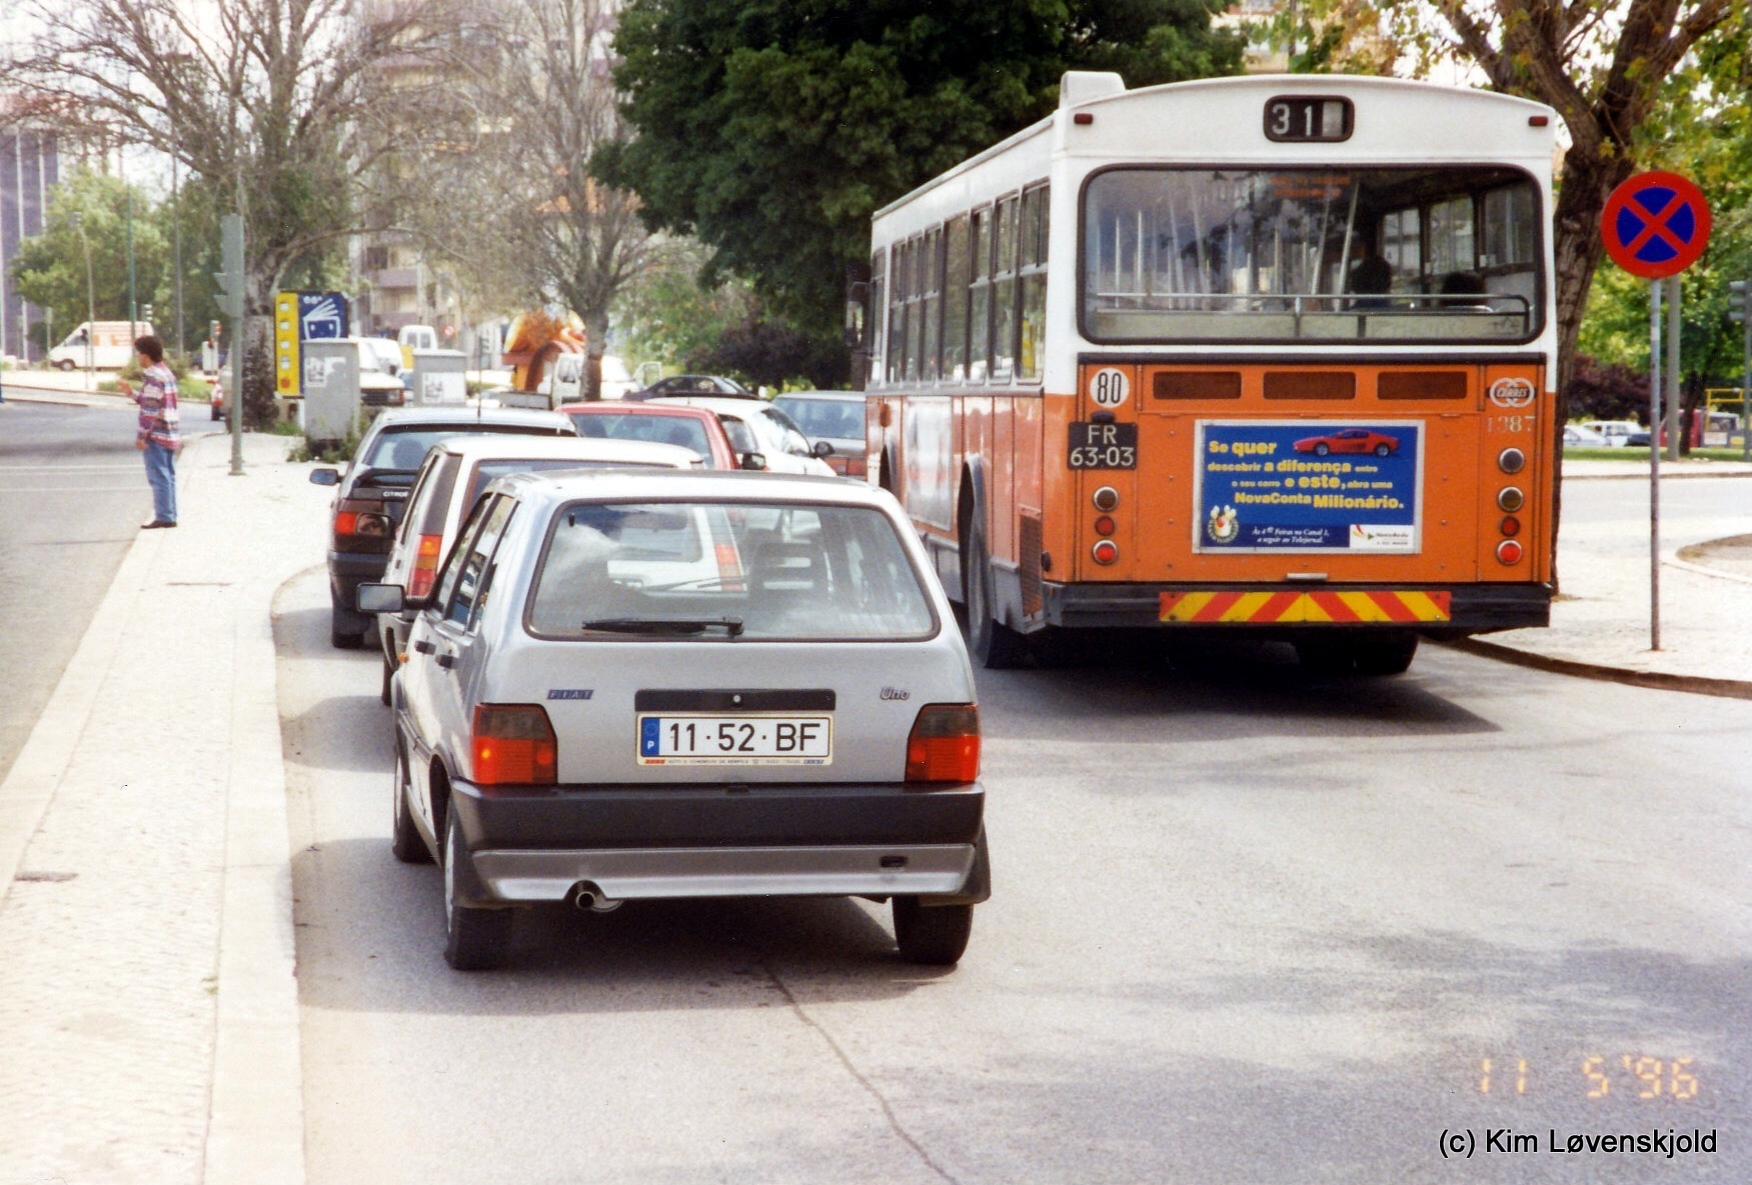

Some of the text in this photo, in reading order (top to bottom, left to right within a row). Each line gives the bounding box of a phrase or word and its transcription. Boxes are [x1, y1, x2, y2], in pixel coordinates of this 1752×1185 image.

[1272, 103, 1312, 136] 31
[1098, 372, 1121, 404] 80
[1088, 425, 1117, 444] FR
[1070, 446, 1134, 466] 63-03
[1208, 440, 1277, 457] Se quer
[1207, 461, 1262, 472] descobrir
[1264, 462, 1274, 472] a
[1276, 459, 1351, 475] diferença
[1298, 474, 1346, 490] este,
[1234, 491, 1312, 504] NovaConta
[548, 690, 593, 699] FIAT
[879, 686, 911, 701] Uno
[647, 740, 655, 750] P
